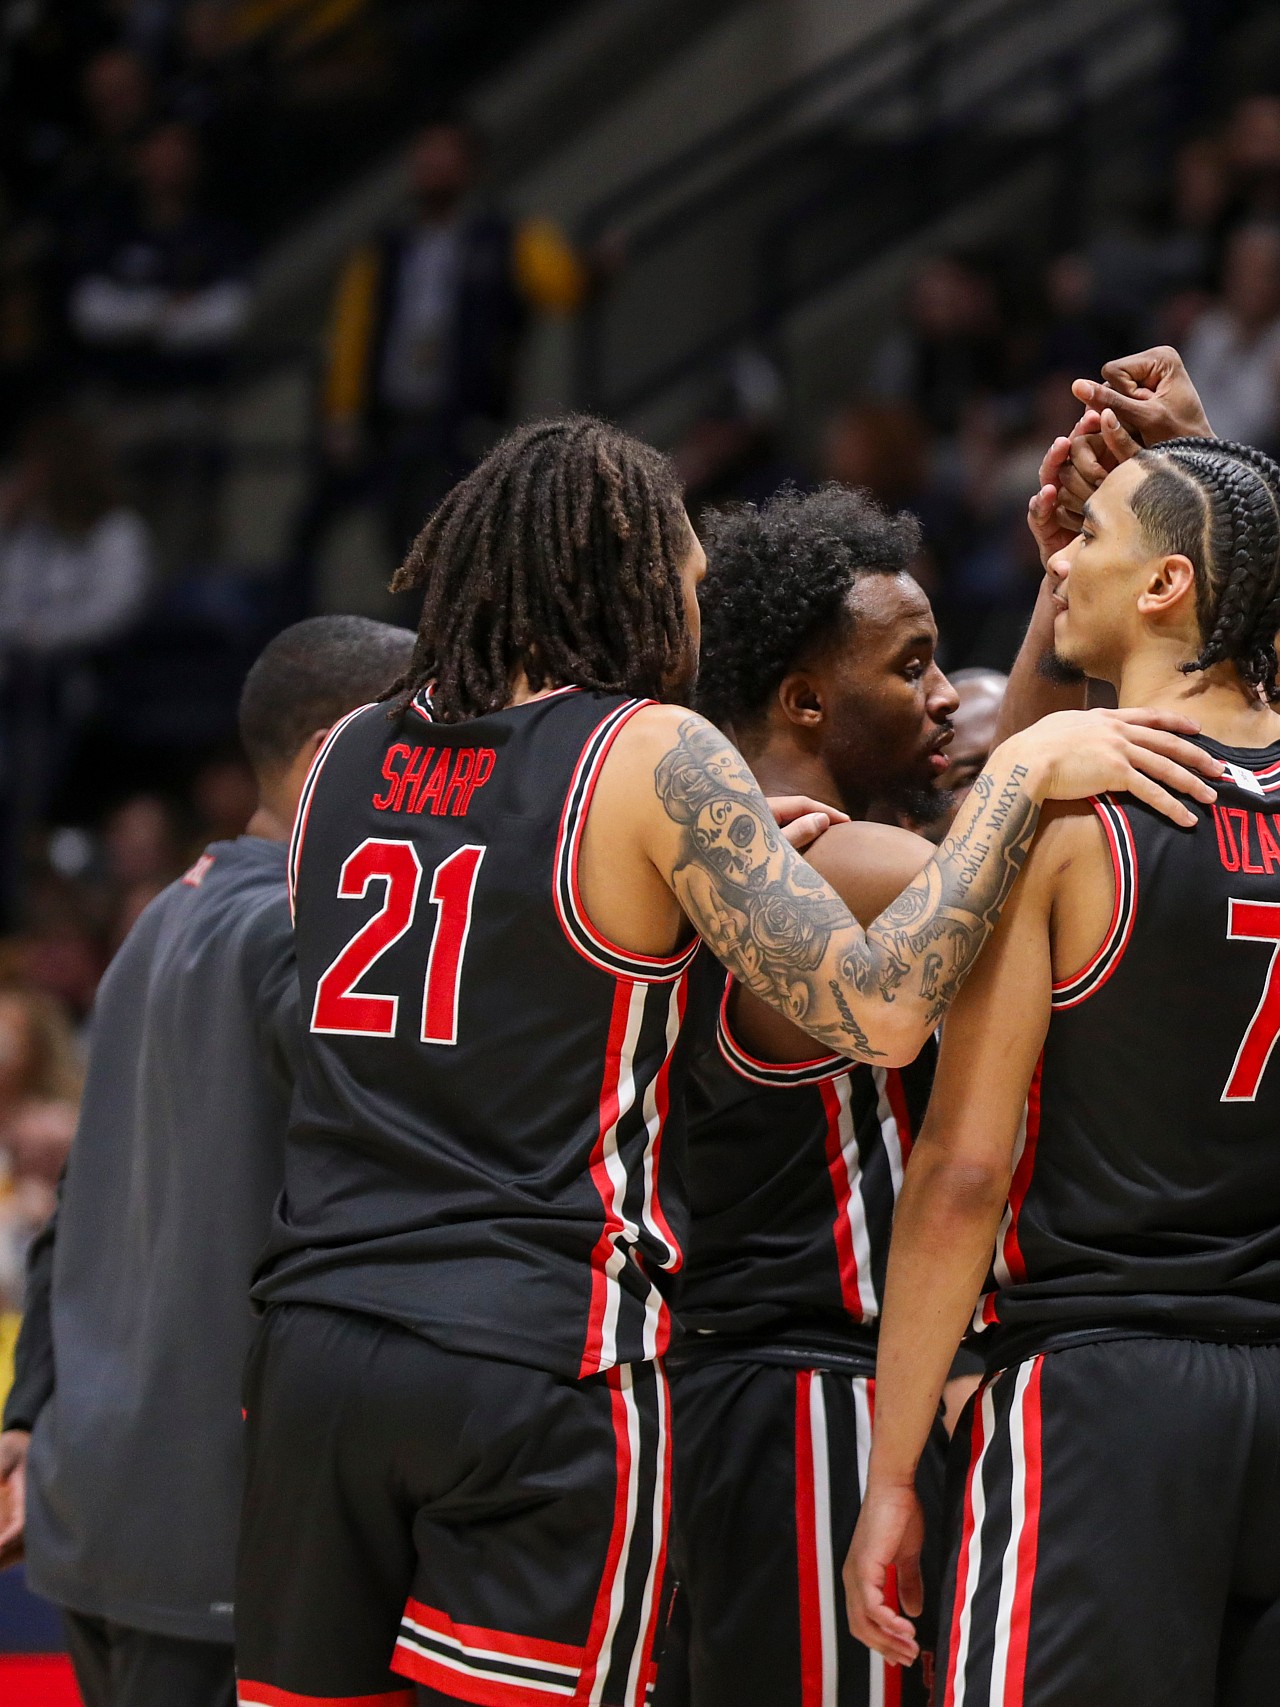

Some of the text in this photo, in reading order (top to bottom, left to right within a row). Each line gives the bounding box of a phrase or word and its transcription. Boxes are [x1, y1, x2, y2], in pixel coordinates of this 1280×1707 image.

[373, 742, 497, 817] SHARP
[987, 763, 1030, 832] MMXVII
[310, 837, 487, 1045] 21
